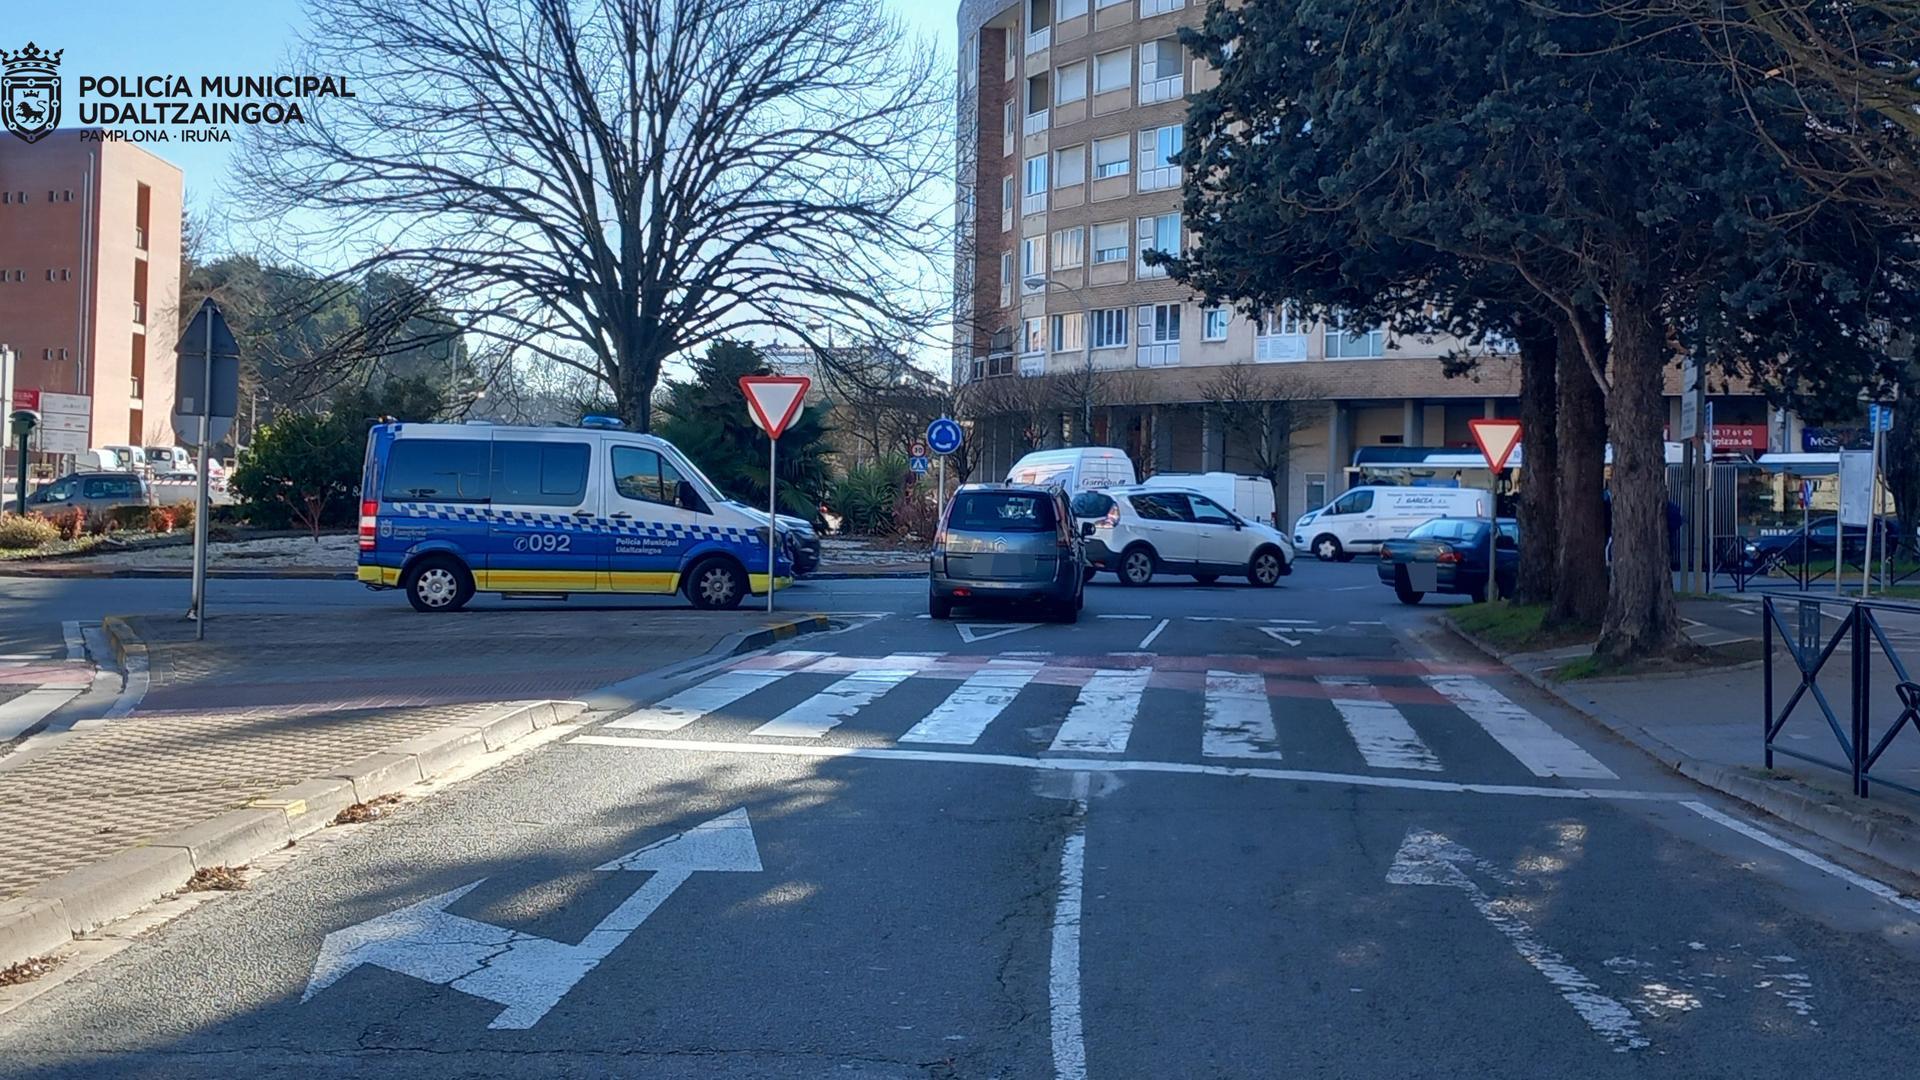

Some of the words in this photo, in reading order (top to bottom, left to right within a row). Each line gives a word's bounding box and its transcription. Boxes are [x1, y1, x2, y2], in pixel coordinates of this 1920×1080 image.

[1809, 436, 1839, 447] MGS
[529, 534, 571, 552] 092
[643, 538, 680, 547] Municipal
